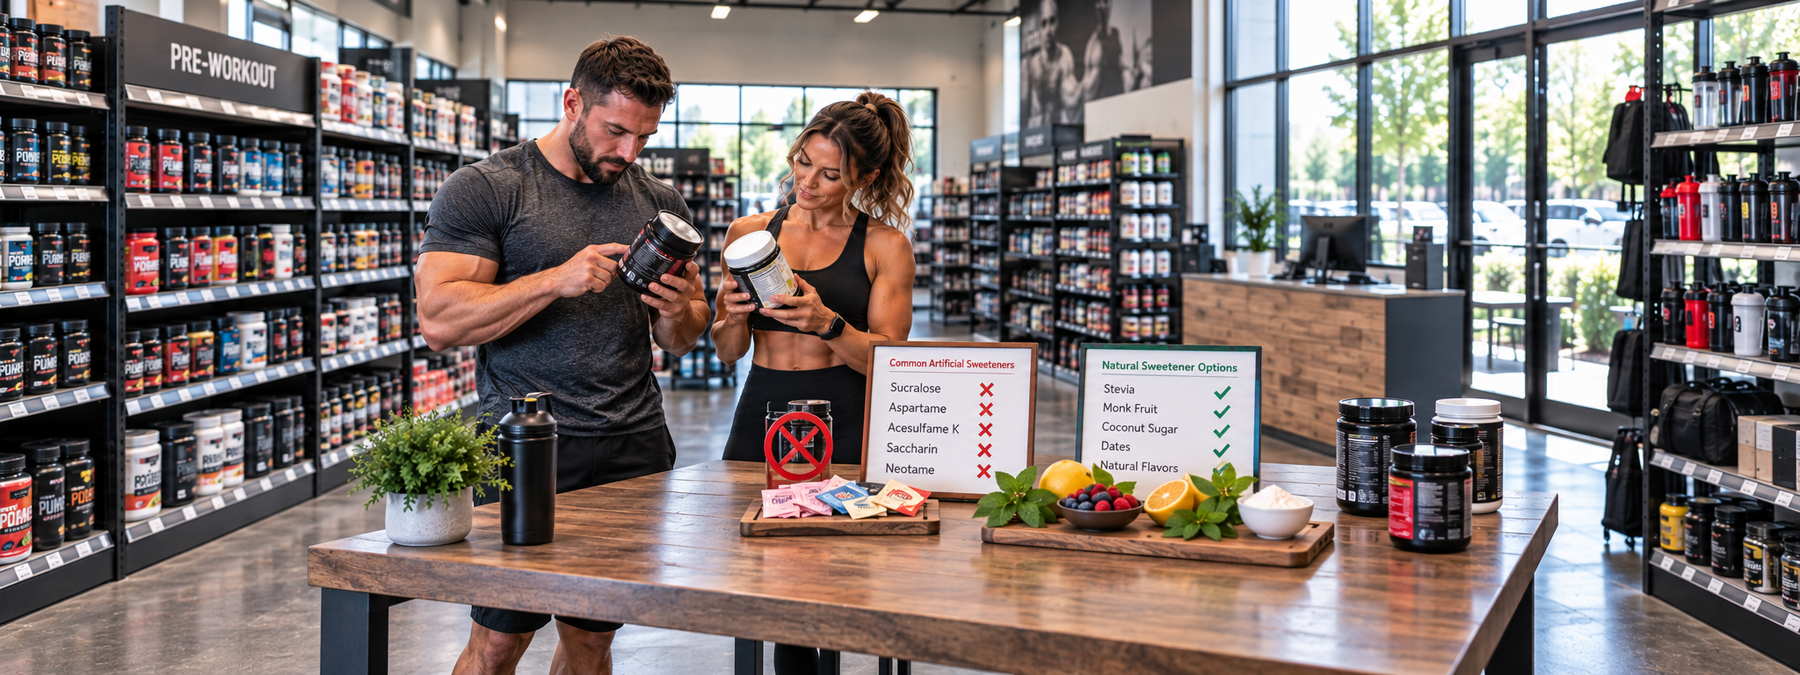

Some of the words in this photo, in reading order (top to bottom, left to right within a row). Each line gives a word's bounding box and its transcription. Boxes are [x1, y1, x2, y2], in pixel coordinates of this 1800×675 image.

[171, 42, 277, 89] PRE-WORKOUT
[889, 357, 927, 368] Common
[928, 357, 965, 369] Artificial
[966, 359, 1015, 370] Sweeteners
[1101, 360, 1139, 371] Natural
[1141, 360, 1196, 372] Sweetener
[1197, 362, 1238, 374] Options
[890, 382, 942, 394] Sucralose
[1103, 383, 1135, 395] Stevia
[888, 402, 947, 415] Aspartame
[1102, 403, 1132, 414] Monk
[1134, 403, 1158, 415] Fruit
[887, 422, 949, 435] Acesulfame
[952, 423, 960, 434] K
[1101, 421, 1146, 433] Coconut
[1147, 423, 1179, 436] Sugar
[886, 442, 938, 455] Saccharin
[1101, 440, 1131, 452] Dates
[885, 463, 935, 476] Neotame
[1100, 460, 1139, 471] Natural
[1141, 461, 1179, 473] Flavors
